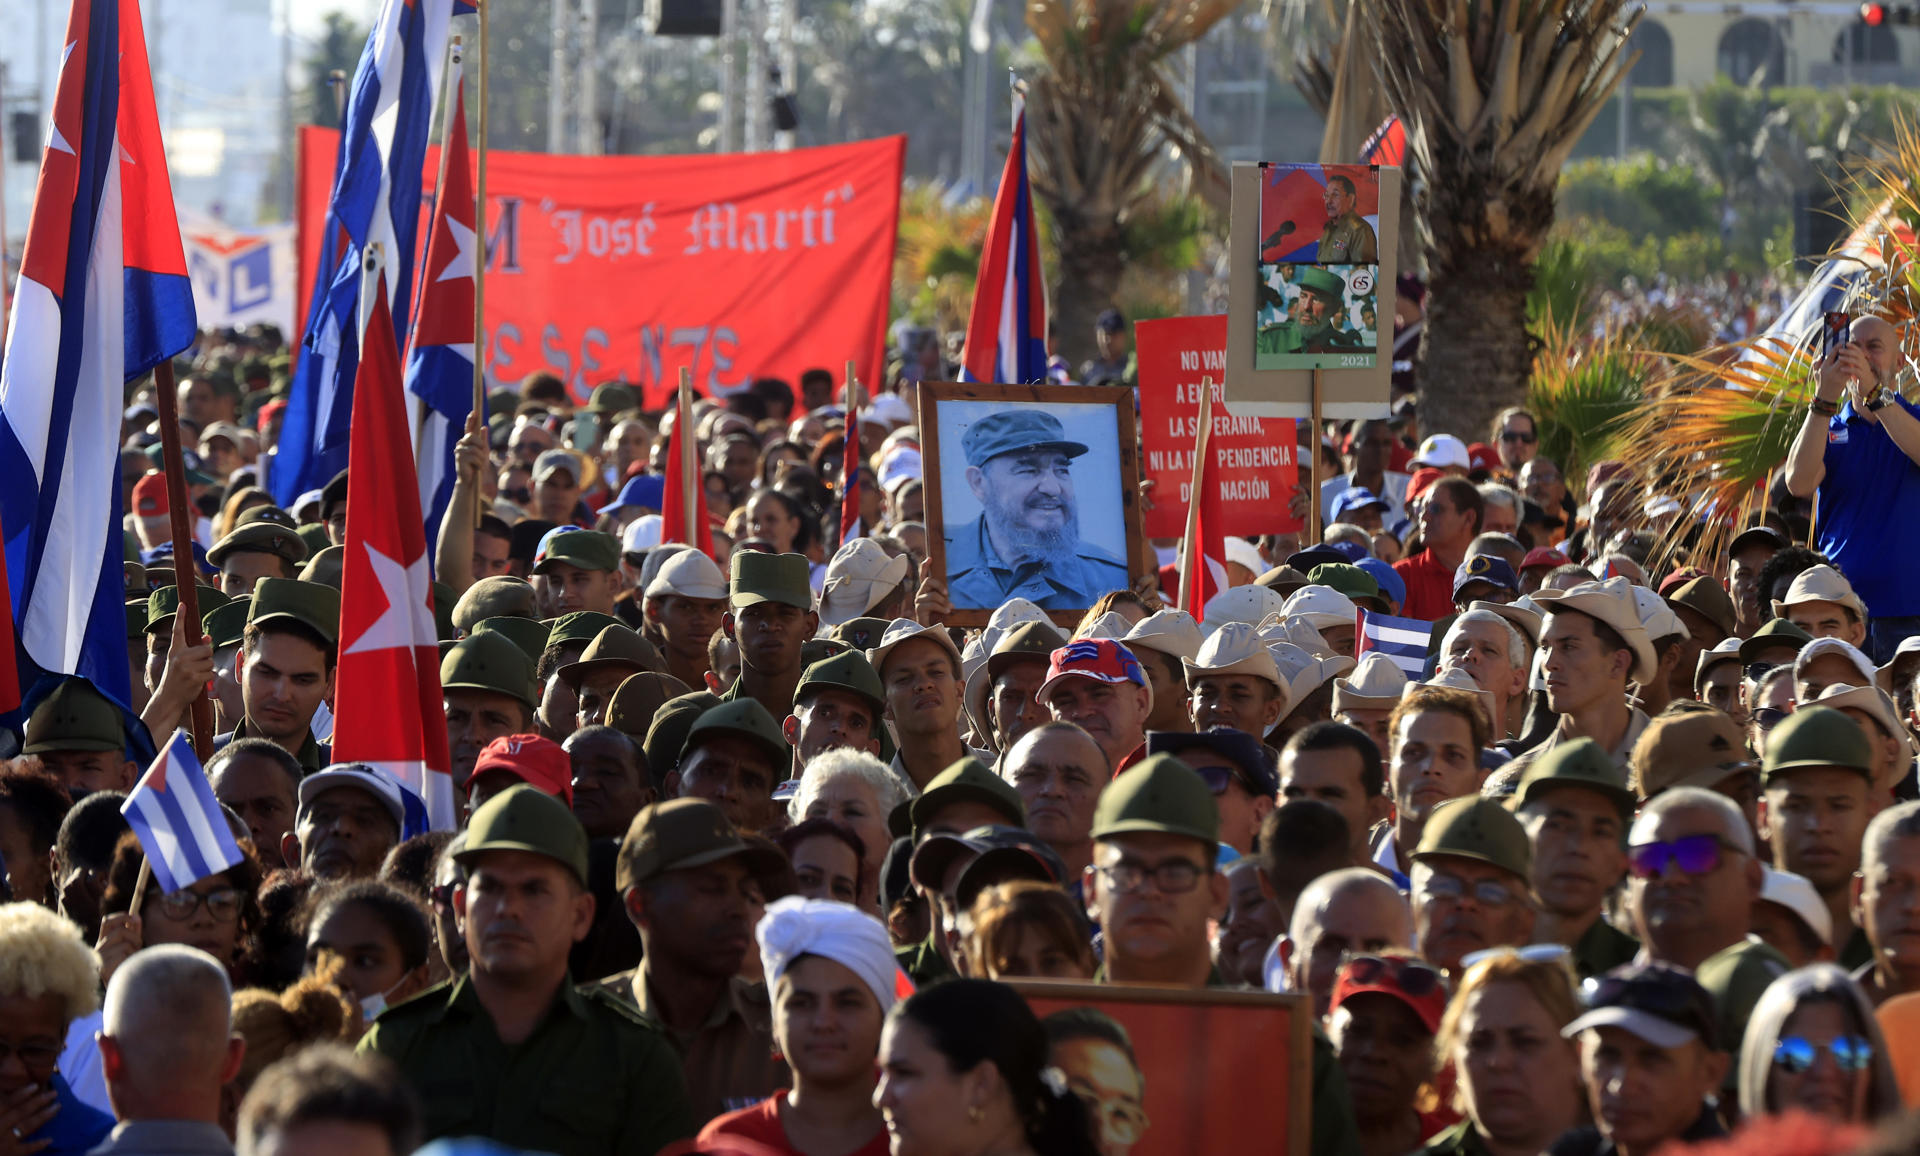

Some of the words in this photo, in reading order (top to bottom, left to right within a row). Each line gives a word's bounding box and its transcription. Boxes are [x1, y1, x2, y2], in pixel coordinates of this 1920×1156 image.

[1180, 350, 1199, 371] NO
[1340, 355, 1371, 367] 2021
[1176, 383, 1185, 404] A
[1169, 417, 1185, 437] LA
[1149, 451, 1164, 471] NI
[1167, 449, 1184, 471] LA
[1220, 476, 1271, 501] NACIÓN
